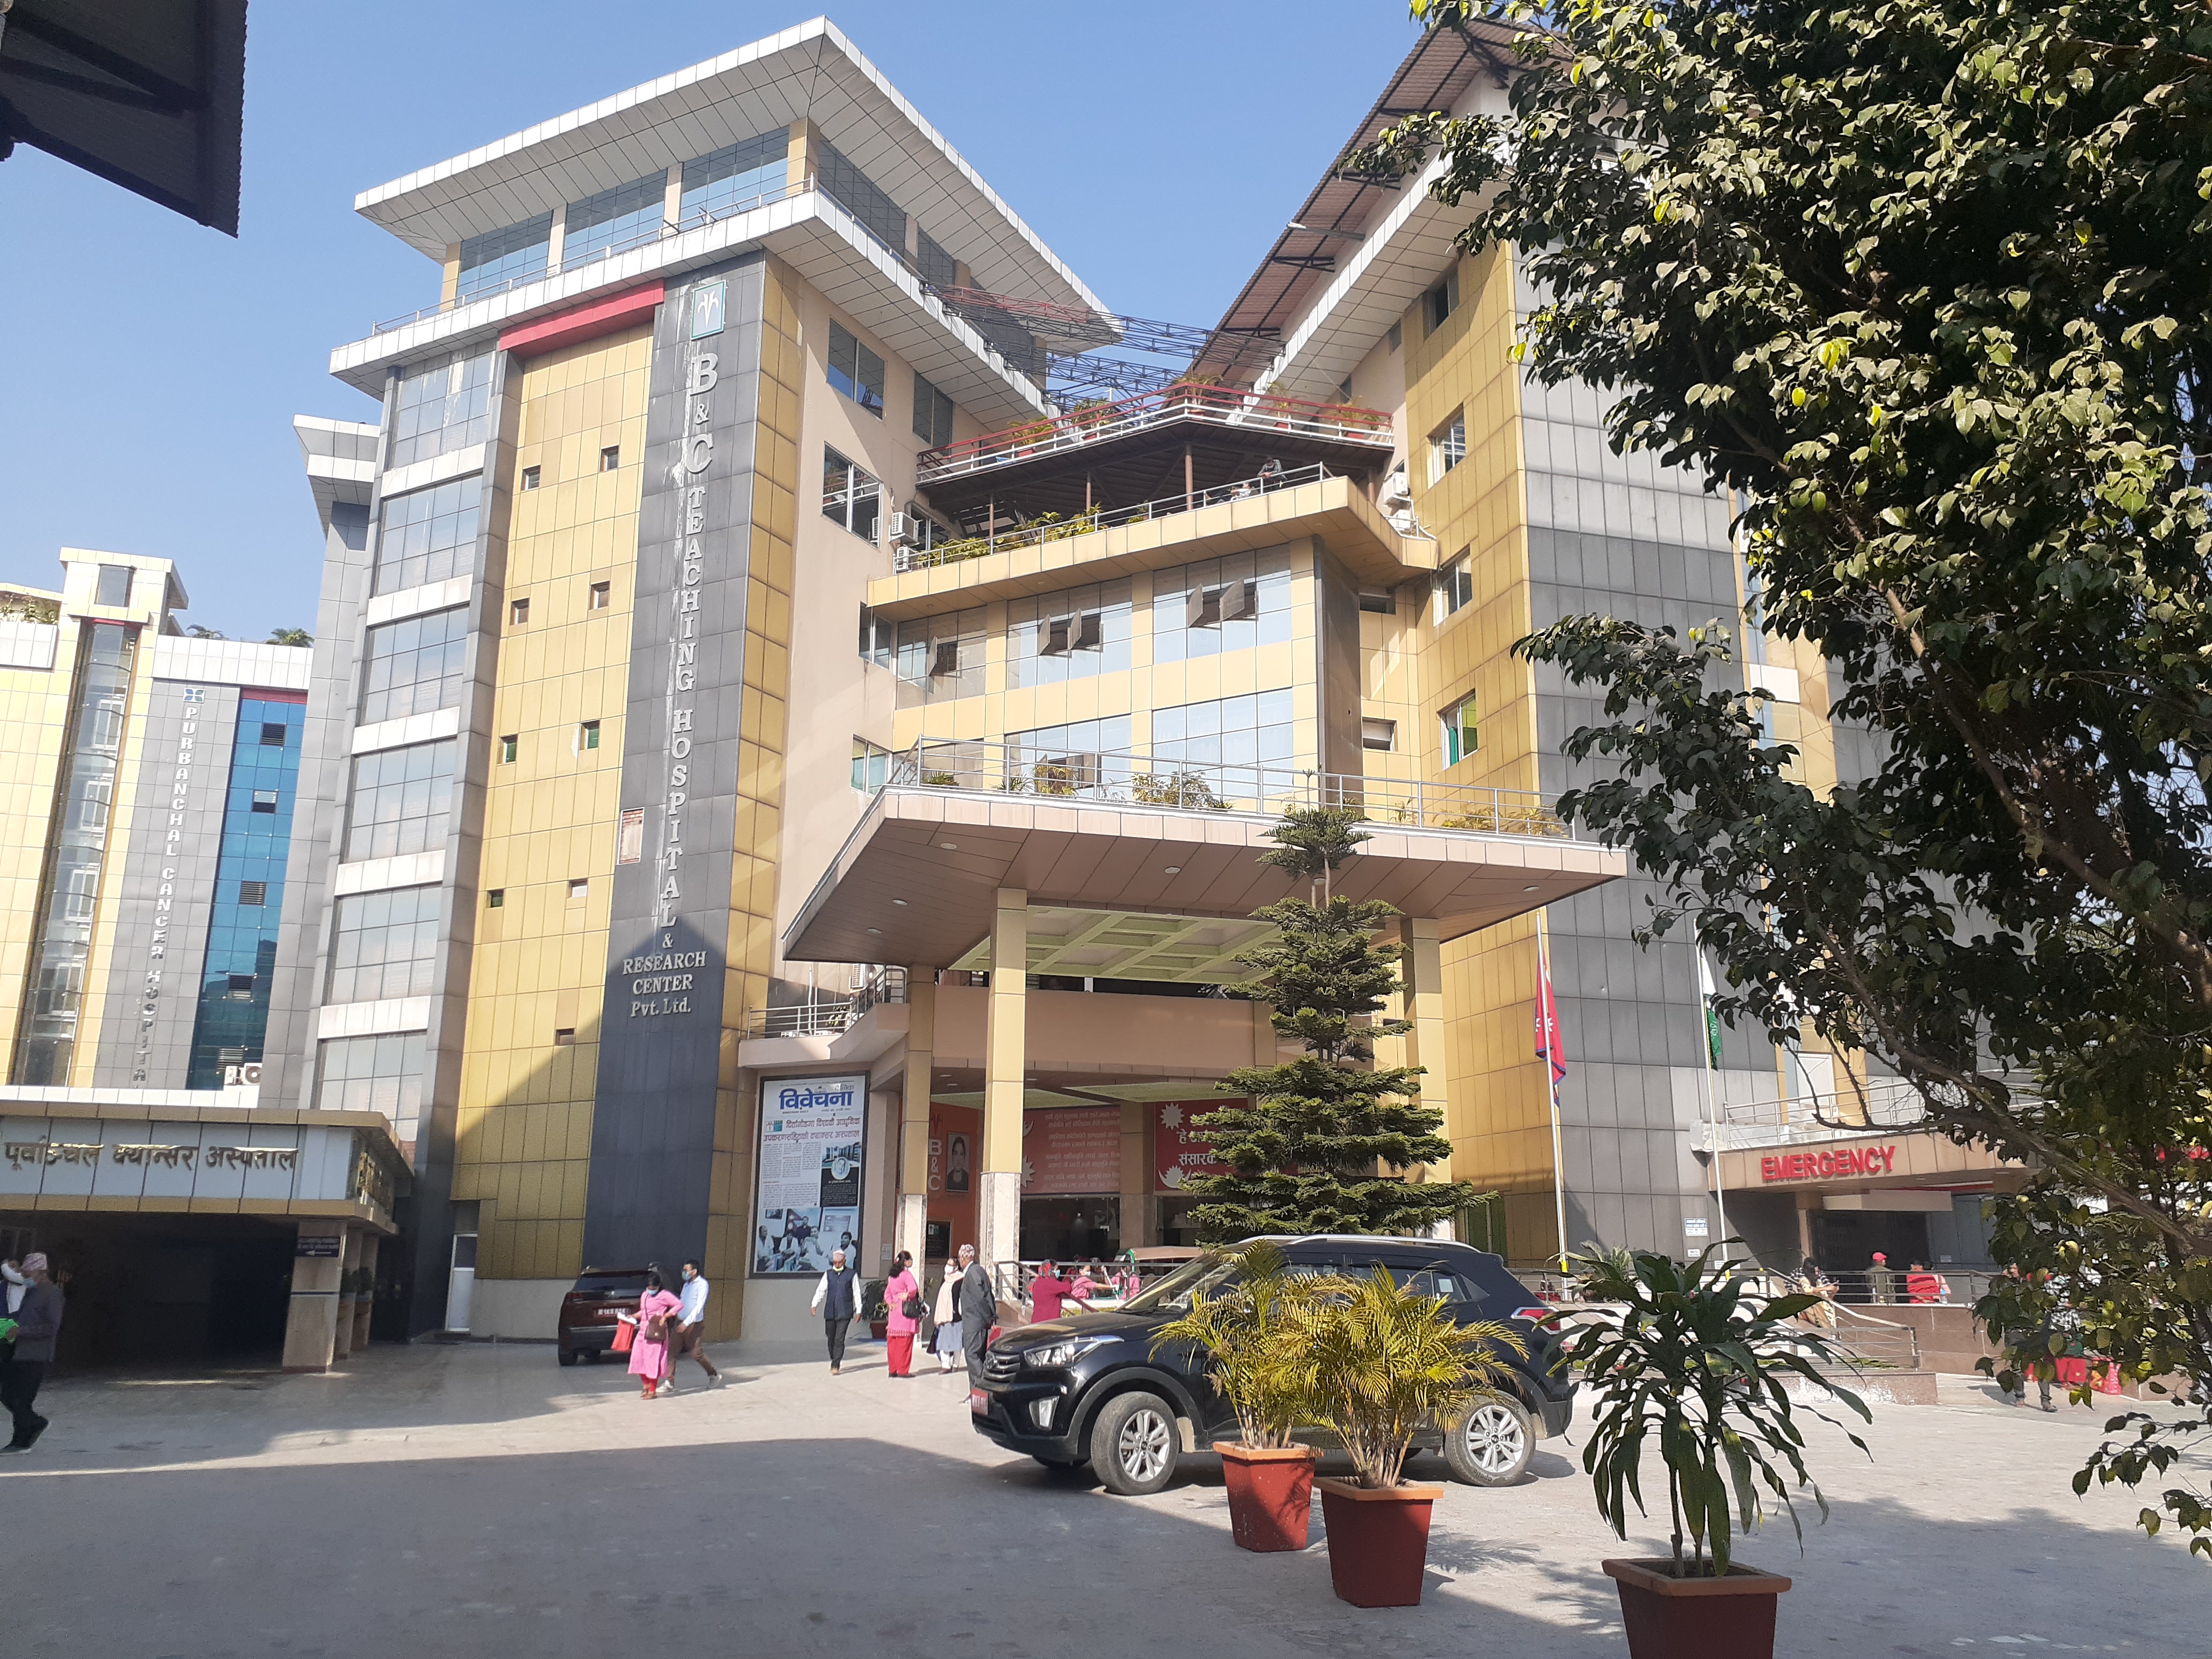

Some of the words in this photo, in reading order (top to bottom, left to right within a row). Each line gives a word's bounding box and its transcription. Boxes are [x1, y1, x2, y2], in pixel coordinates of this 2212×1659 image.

[689, 352, 719, 396] B
[694, 403, 709, 425] &
[686, 434, 713, 474] C
[675, 487, 707, 693] TEACHING
[166, 706, 198, 857] PURBANCHAL
[660, 708, 693, 928] HOSPITAL
[151, 866, 176, 960] CANCER
[662, 933, 674, 948] &
[622, 951, 707, 975] RESEARCH
[633, 974, 693, 995] CENTER
[630, 1000, 660, 1017] Pvt.
[662, 997, 692, 1014] Ltd.
[133, 970, 161, 1088] HOSPITA
[779, 1087, 854, 1110] विवेचना
[206, 1146, 299, 1170] अस्पताल
[928, 1139, 942, 1155] B
[931, 1156, 938, 1174] &
[1761, 1146, 1896, 1180] EMERGENCY
[928, 1174, 941, 1191] C
